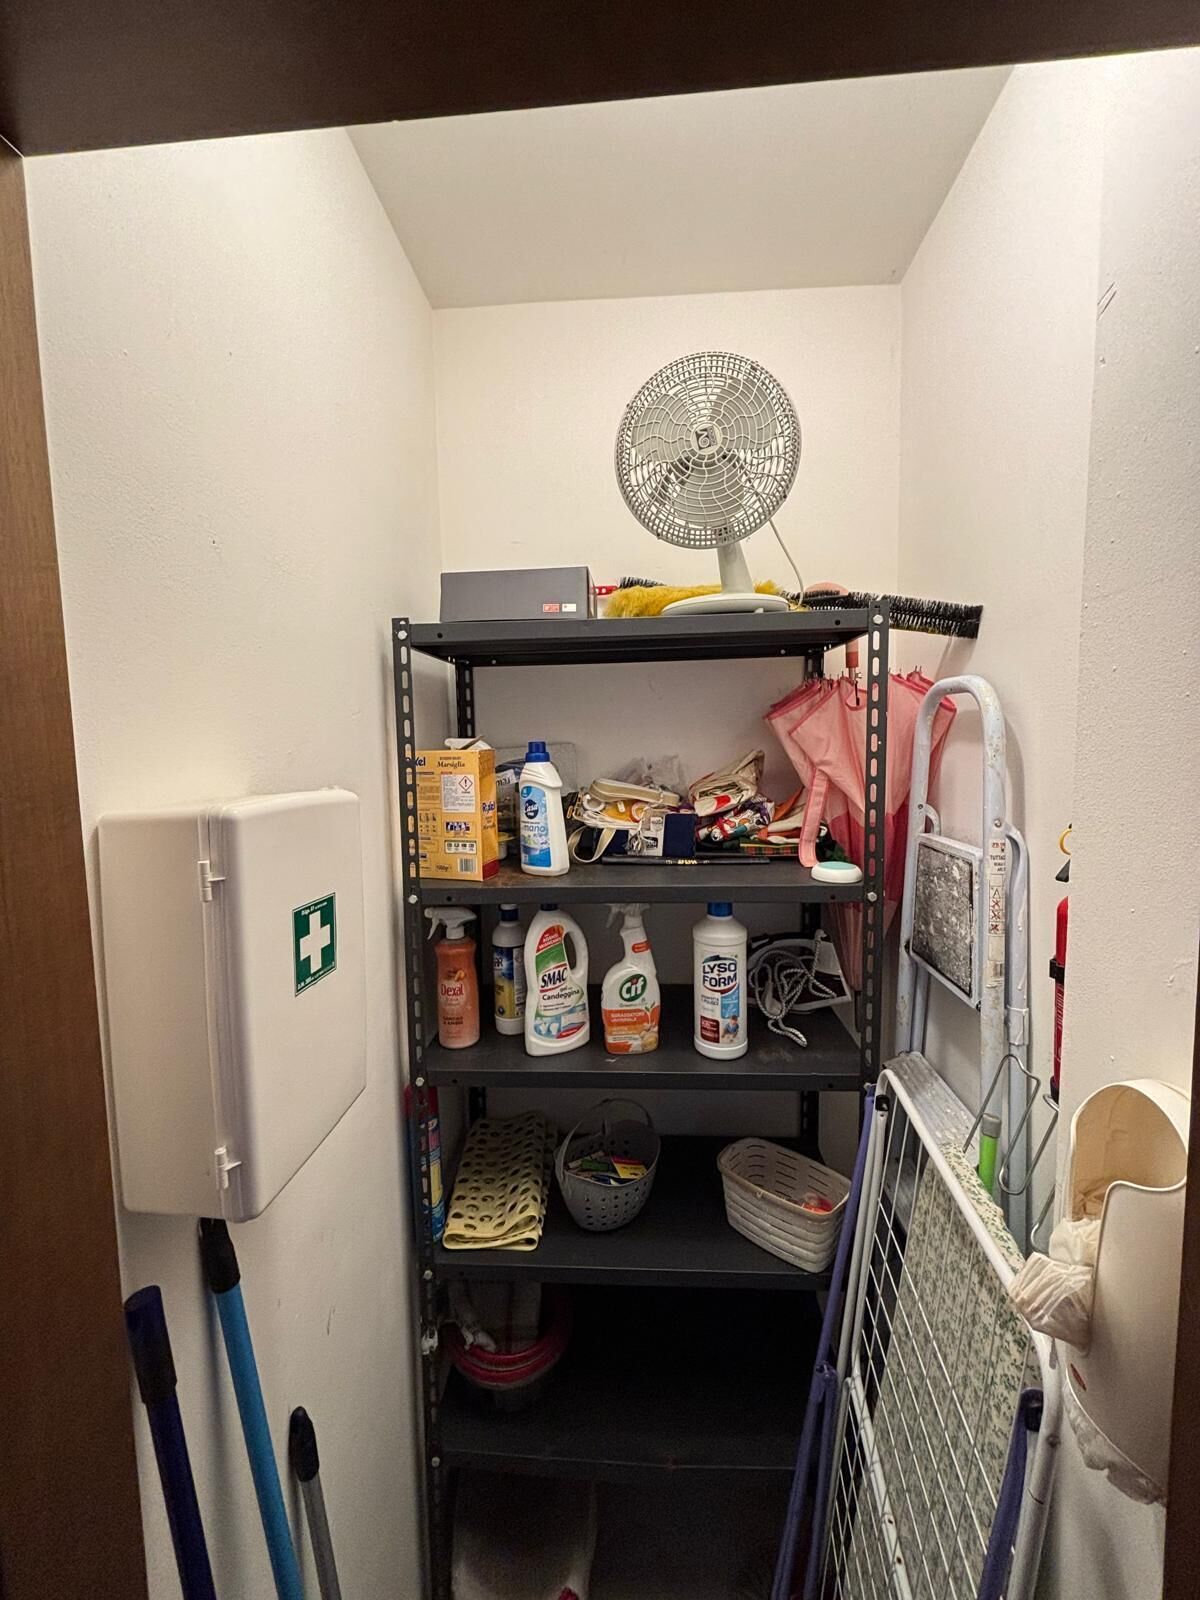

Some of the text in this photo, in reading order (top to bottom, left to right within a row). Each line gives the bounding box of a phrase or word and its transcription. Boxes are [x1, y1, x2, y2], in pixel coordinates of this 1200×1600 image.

[437, 760, 466, 769] Marsiglia
[702, 962, 737, 974] LYSO
[541, 967, 567, 988] SMAC
[703, 973, 737, 988] FORM
[441, 984, 464, 997] Dexal
[621, 976, 645, 998] Cif
[542, 989, 580, 1002] Candeggina
